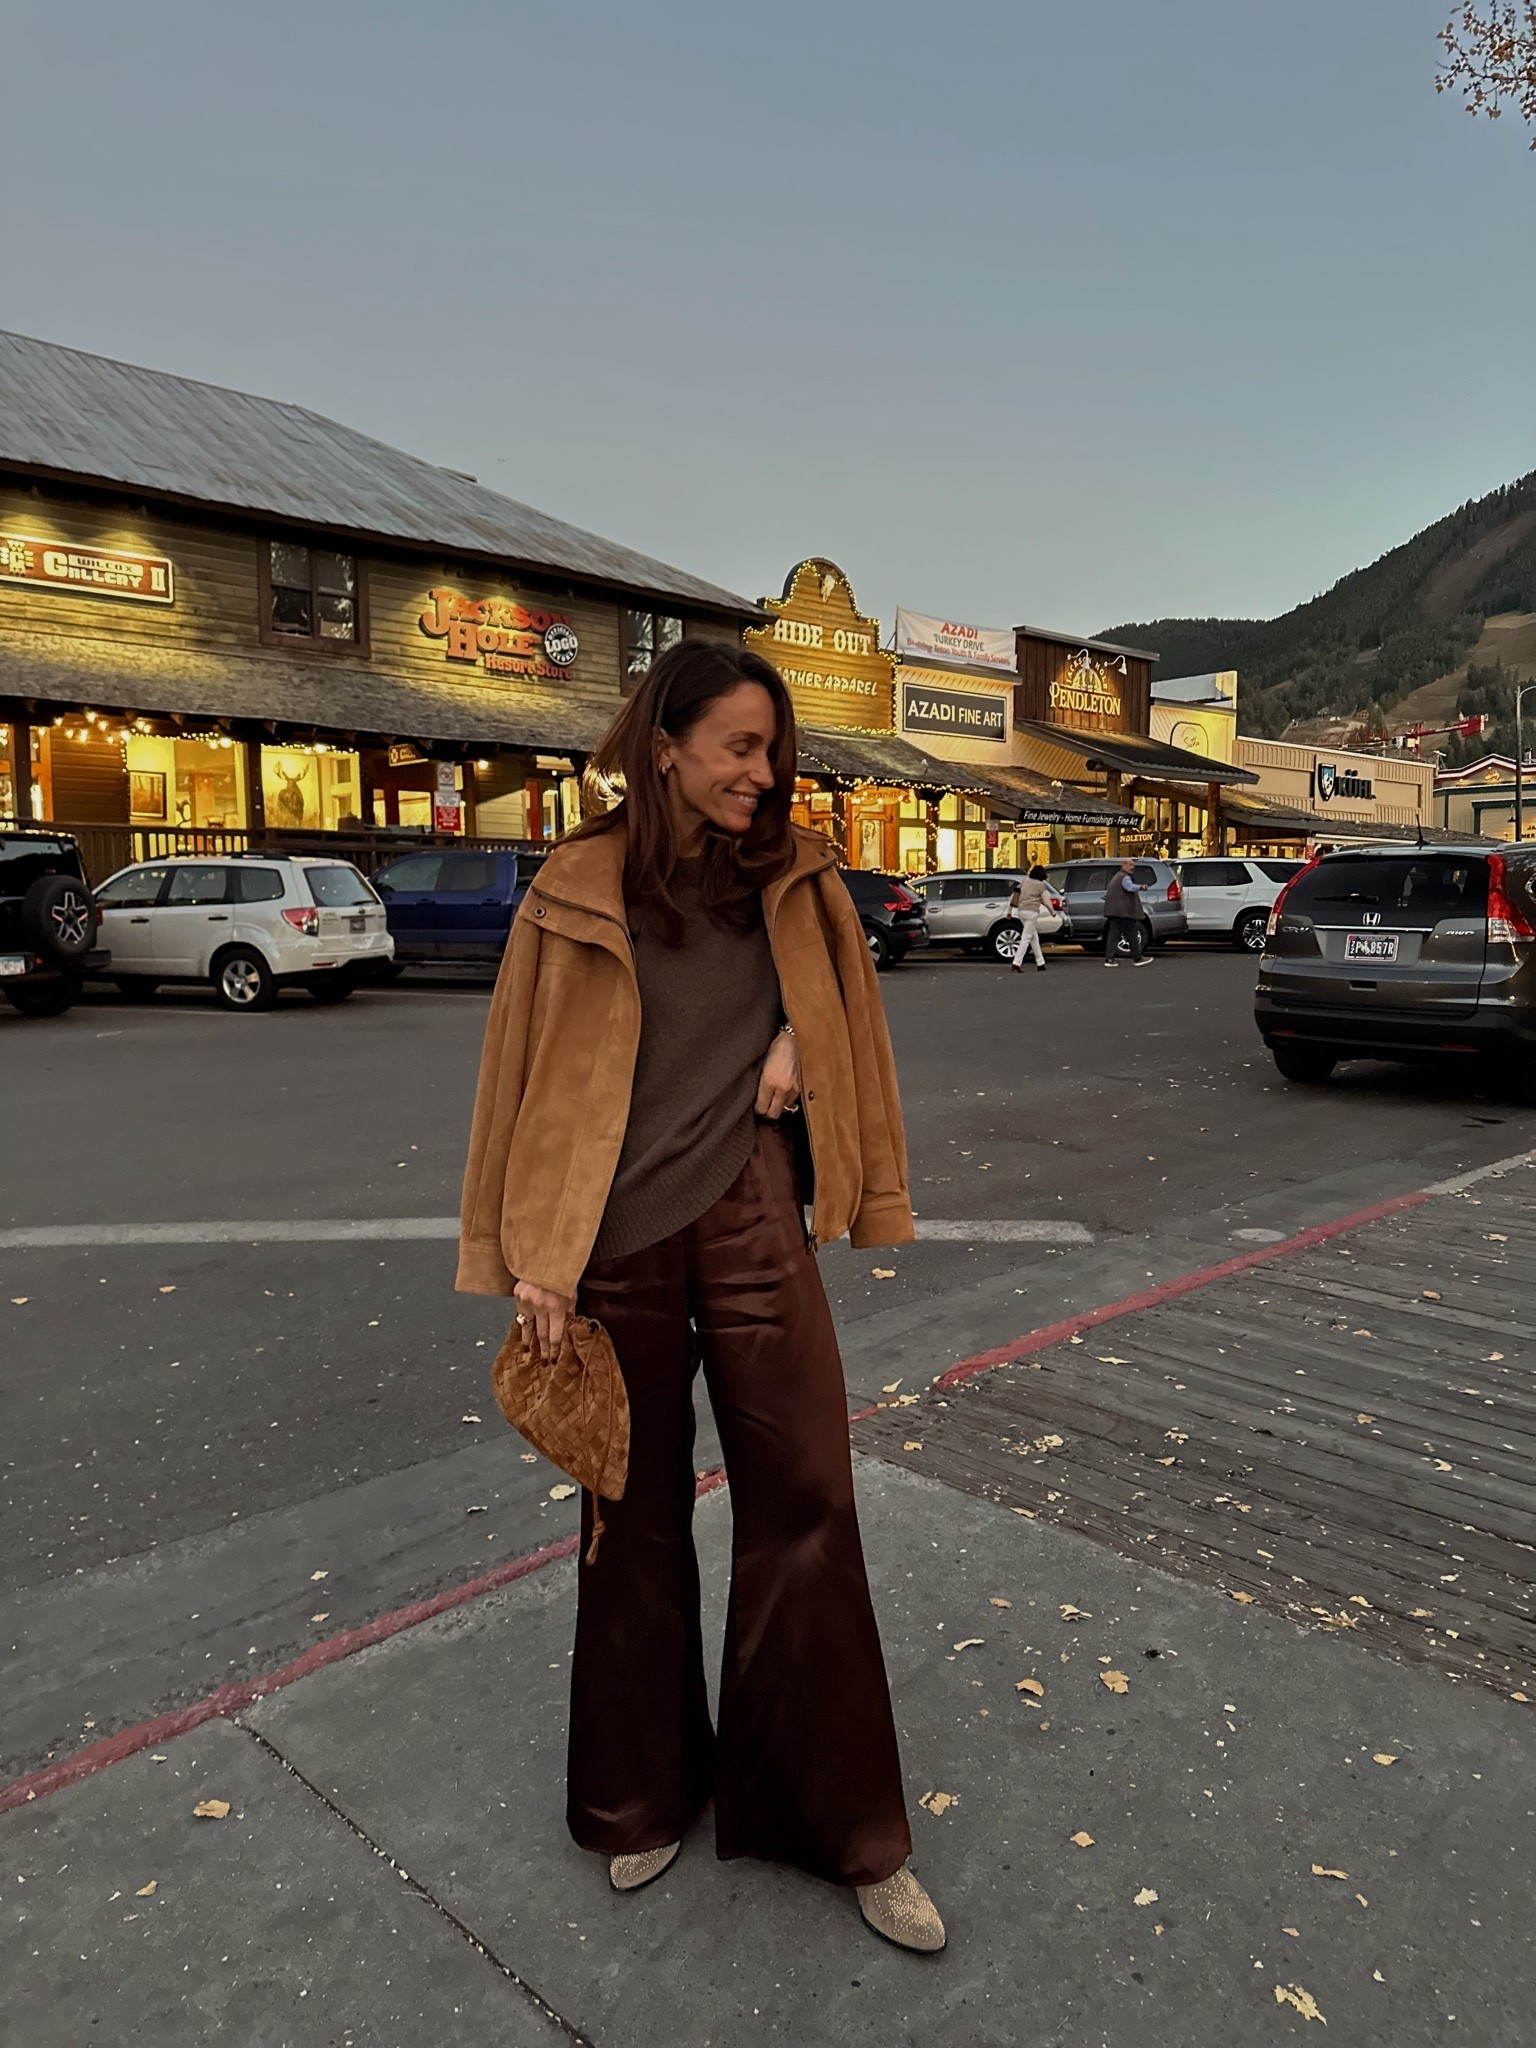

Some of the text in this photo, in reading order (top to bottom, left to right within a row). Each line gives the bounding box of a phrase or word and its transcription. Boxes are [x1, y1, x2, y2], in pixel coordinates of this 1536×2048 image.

[43, 550, 143, 588] GALLERY
[77, 557, 133, 573] WILCOX
[421, 588, 571, 636] JACKSON
[447, 620, 539, 660] HOLE
[544, 636, 578, 653] LOGO
[773, 618, 871, 656] HIDE OUT
[934, 633, 985, 652] TURKEY DRIVE
[940, 622, 978, 640] AZADI
[485, 651, 574, 681] Resort Store
[1095, 662, 1108, 690] HOLE
[824, 674, 878, 696] APPAREL
[1049, 681, 1121, 716] PENDLETON
[907, 700, 1003, 728] AZADI FINE ART
[1024, 810, 1038, 820] Fine
[1038, 811, 1060, 823] Jewelry
[1065, 813, 1081, 823] Home
[1082, 814, 1114, 826] Furnishings
[1117, 817, 1129, 825] Fine
[1129, 817, 1139, 826] Art
